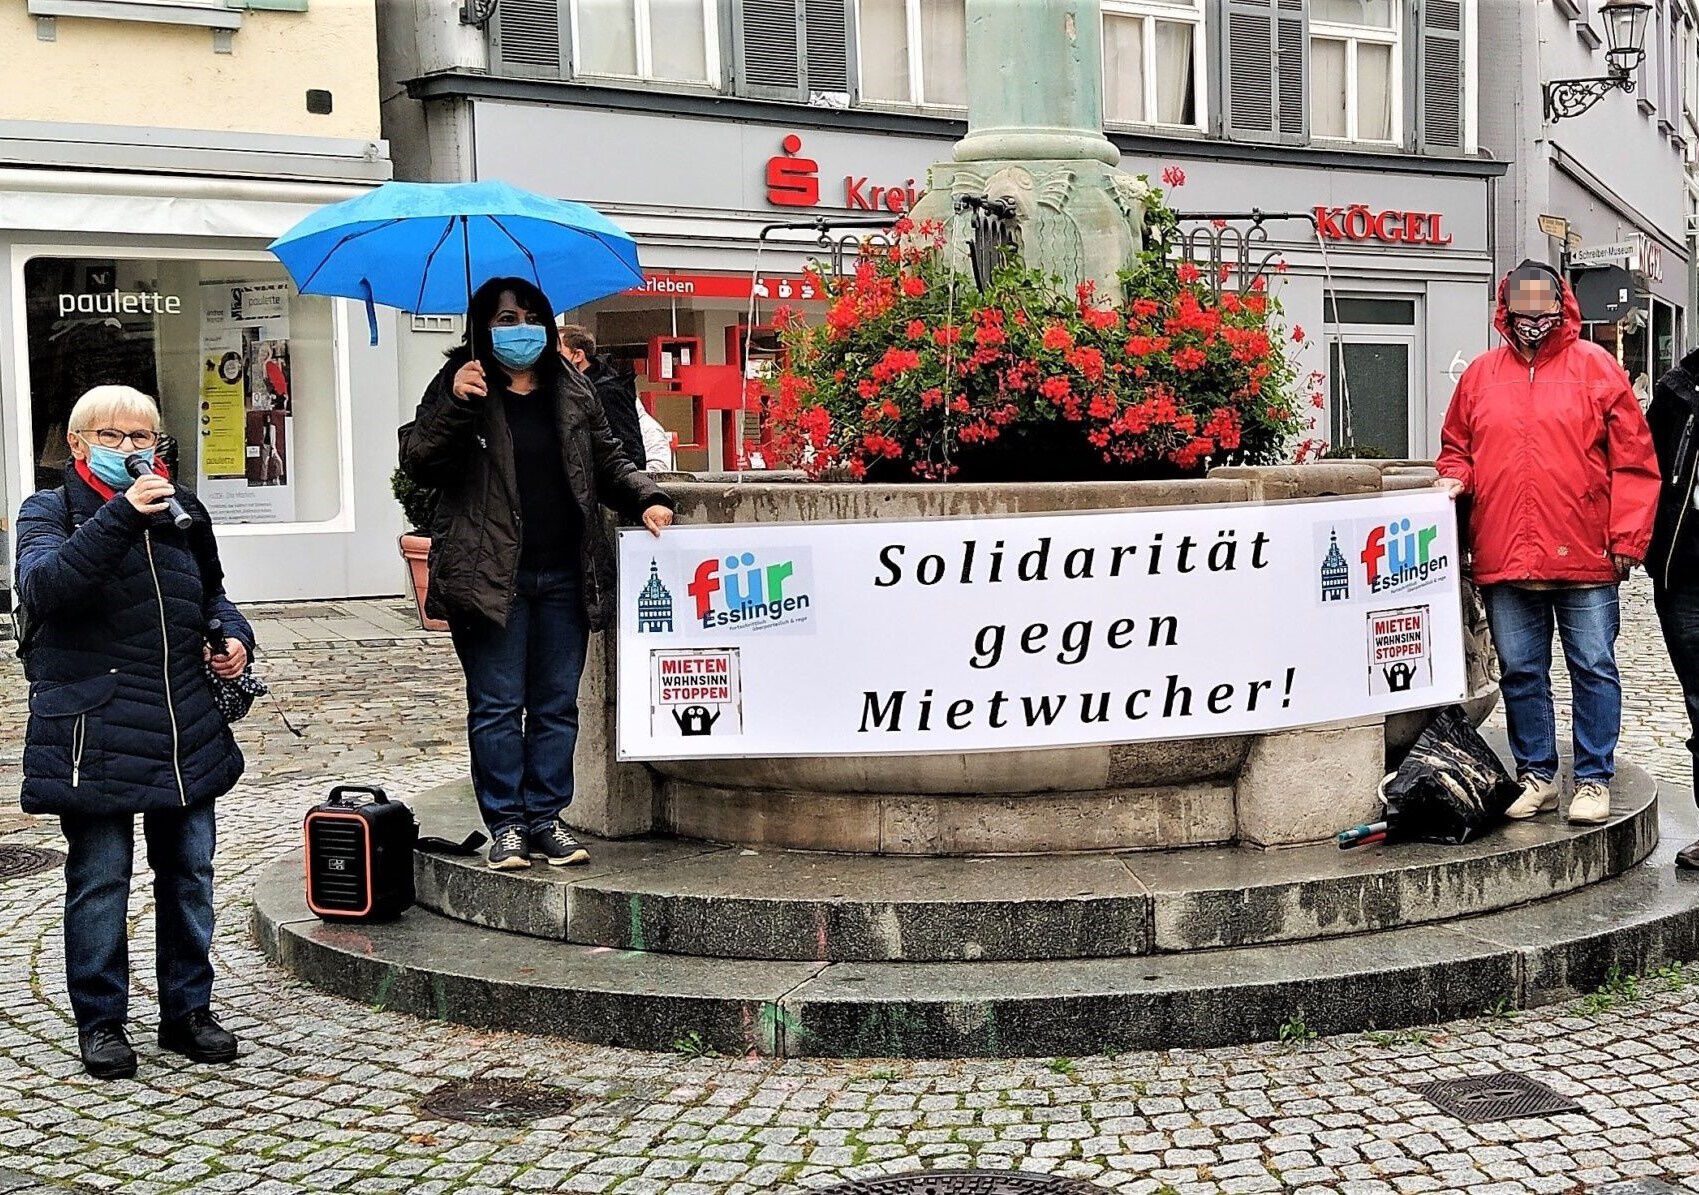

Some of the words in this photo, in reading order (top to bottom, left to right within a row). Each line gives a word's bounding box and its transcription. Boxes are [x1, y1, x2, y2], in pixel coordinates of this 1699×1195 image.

[845, 175, 925, 213] Krei
[1313, 203, 1453, 244] KÖGEL
[58, 288, 181, 317] paulette
[874, 529, 1271, 588] Solidarität
[1360, 517, 1438, 585] für
[687, 552, 794, 620] für
[1371, 554, 1449, 594] Esslingen
[702, 594, 811, 629] Esslingen
[1375, 615, 1421, 636] MIETEN
[968, 614, 1180, 669] gegen
[1375, 631, 1421, 647] WAHNSINN
[1375, 641, 1422, 660] STOPPEN
[661, 674, 728, 687] WAHNSINN
[662, 658, 727, 674] MIETEN
[662, 686, 728, 700] STOPPEN
[857, 667, 1296, 733] Mietwucher!
